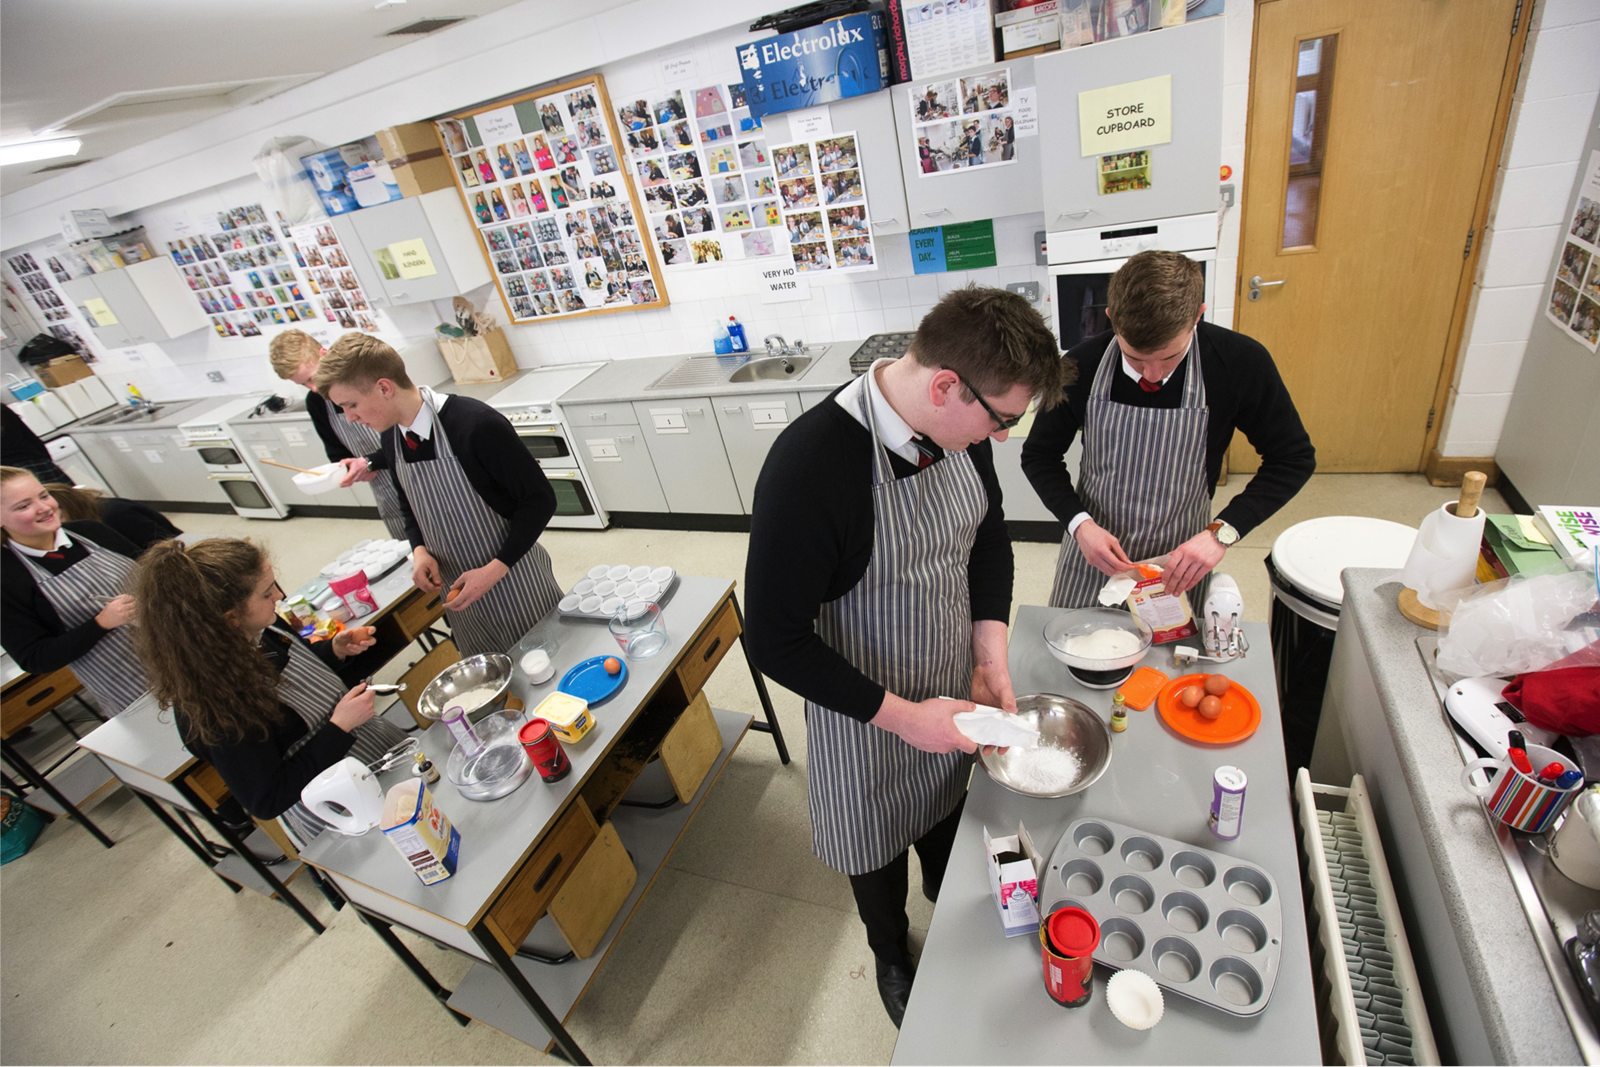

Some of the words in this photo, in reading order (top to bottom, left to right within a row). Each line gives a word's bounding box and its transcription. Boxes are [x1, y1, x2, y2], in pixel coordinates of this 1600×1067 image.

[761, 26, 864, 65] Electrolux
[896, 41, 908, 80] morphy
[1106, 103, 1144, 119] STORE
[1096, 117, 1156, 135] CUPBOARD
[915, 237, 935, 249] EVERY
[402, 249, 417, 257] HAND
[763, 269, 781, 279] VERY
[783, 267, 795, 276] HO
[770, 281, 797, 291] WATER
